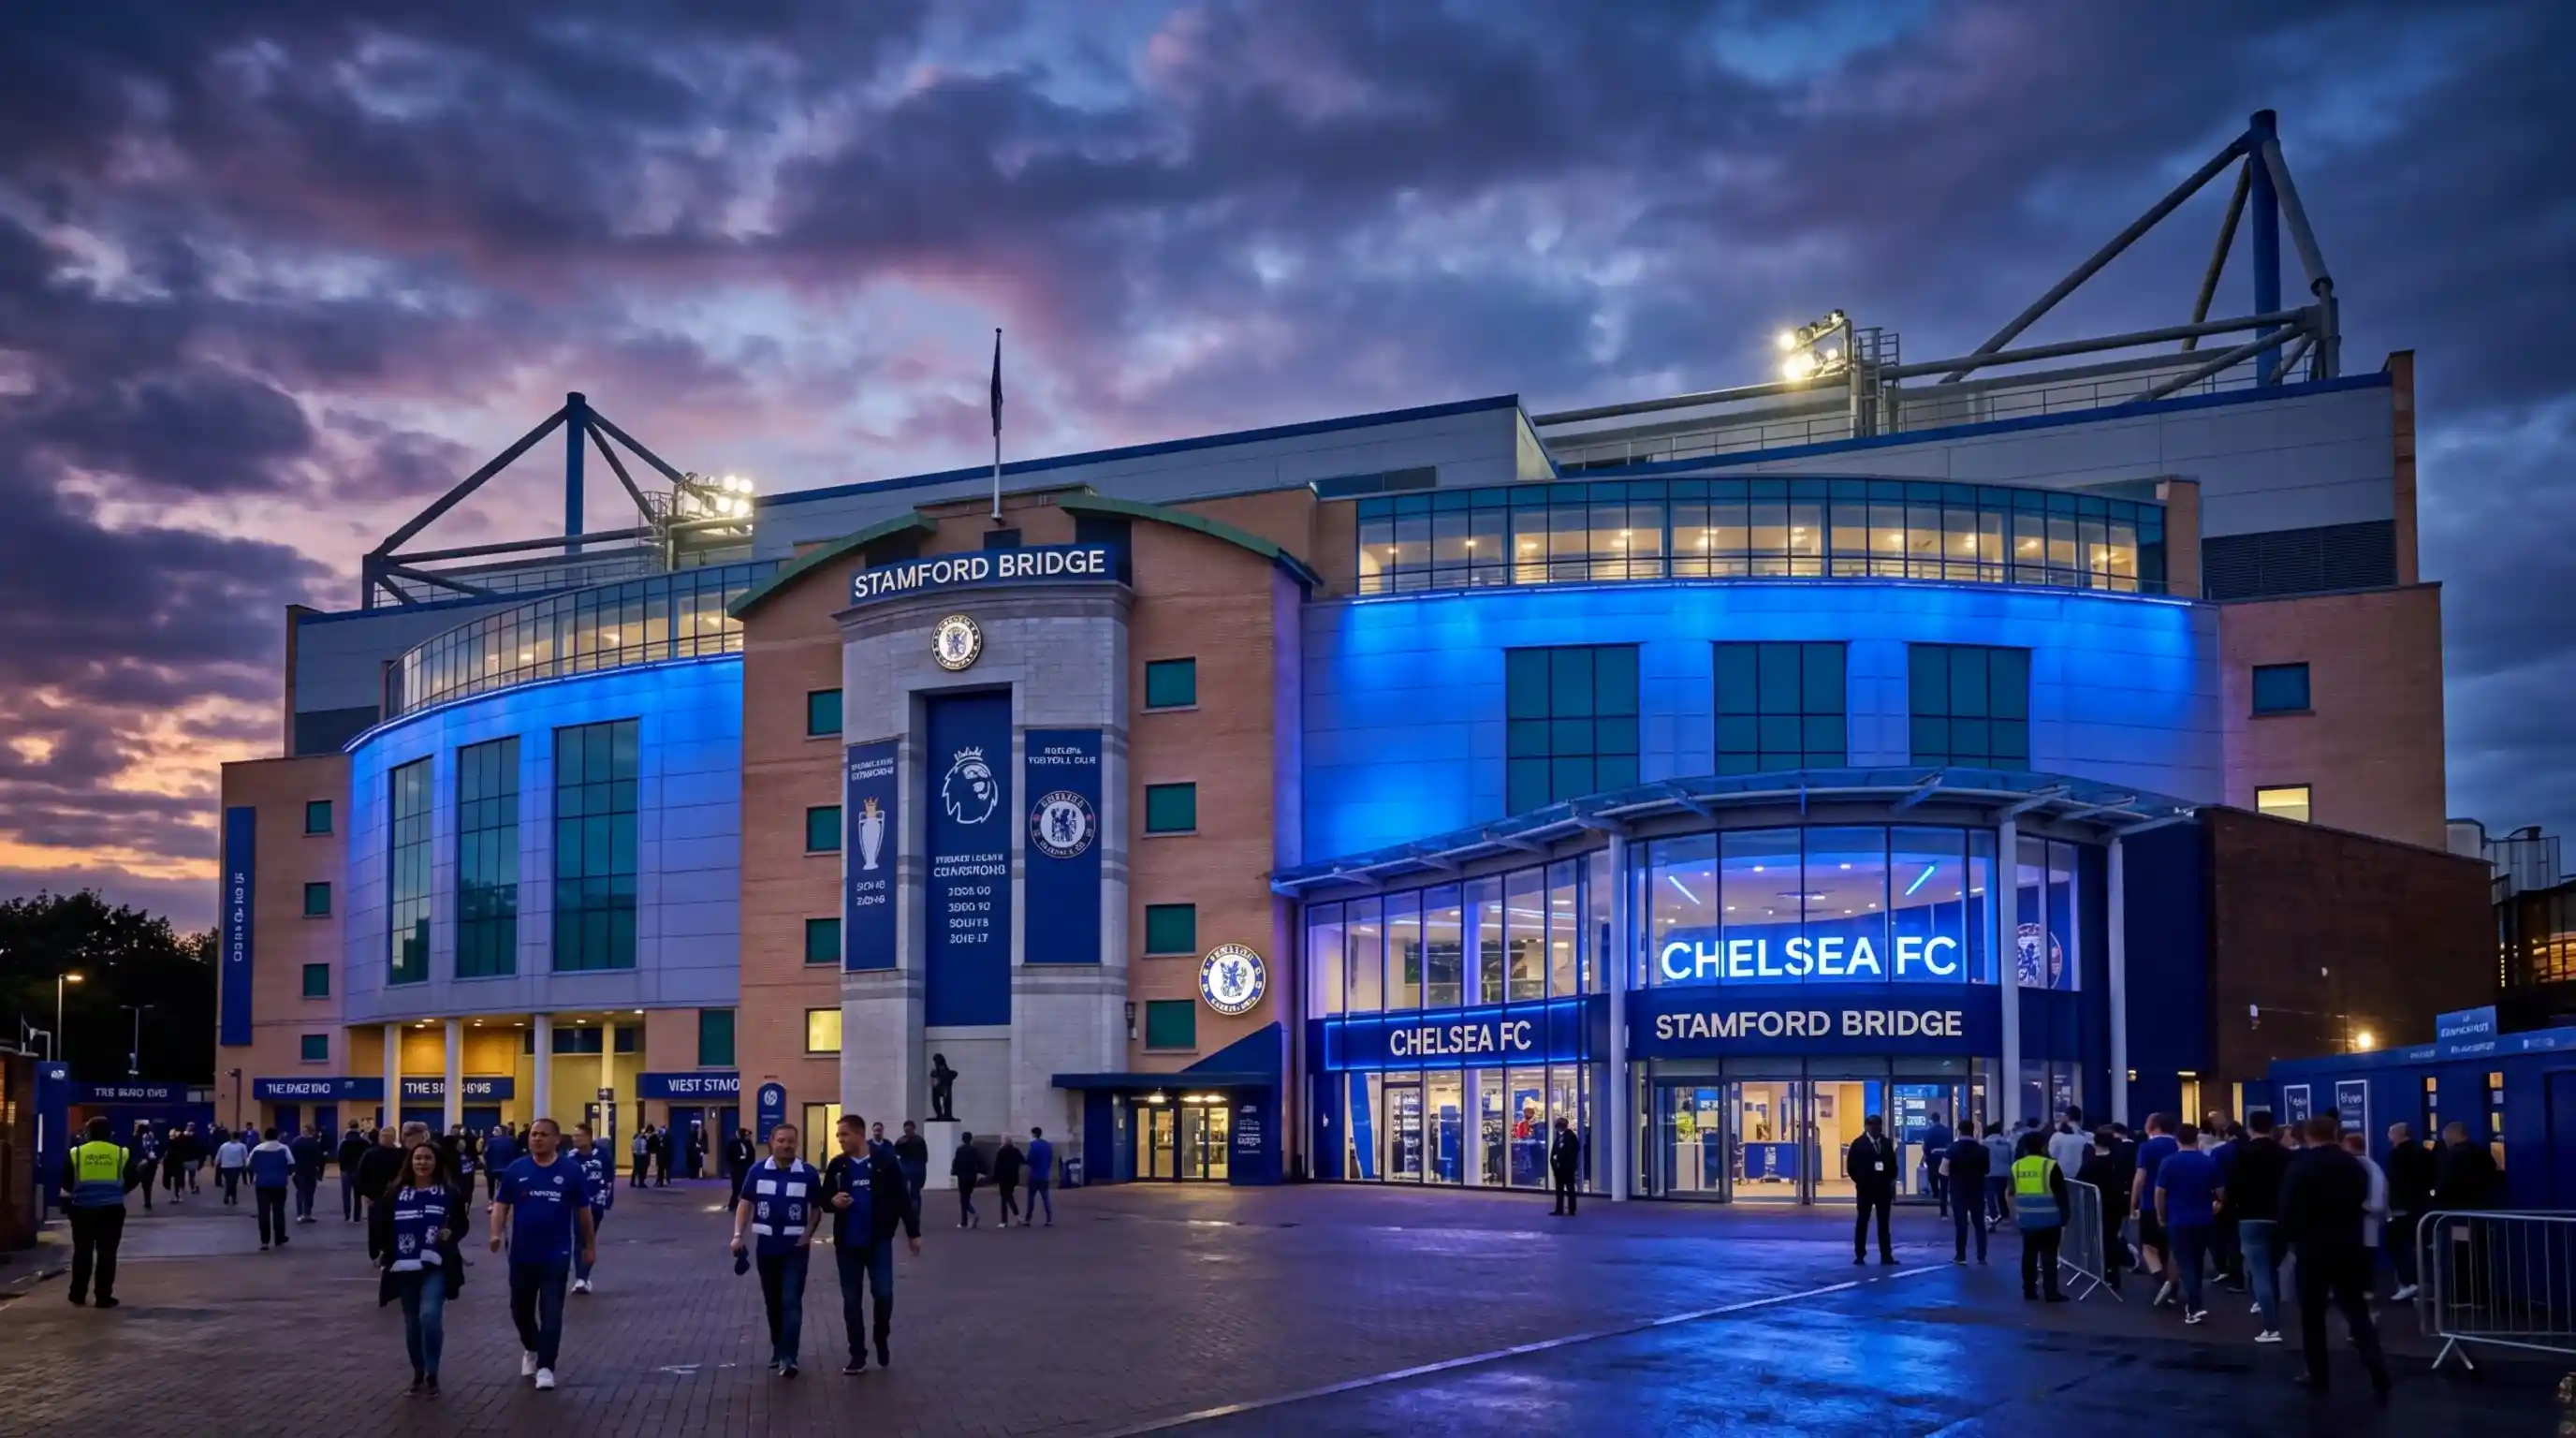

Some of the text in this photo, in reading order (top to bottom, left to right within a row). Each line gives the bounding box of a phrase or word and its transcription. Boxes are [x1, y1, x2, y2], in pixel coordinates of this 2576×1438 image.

[855, 550, 1105, 597] STAMFORD BRIDGE
[1661, 936, 1957, 979] CHELSEA FC
[1390, 1020, 1532, 1056] CHELSEA FC
[1655, 1010, 1963, 1039] STAMFORD BRIDGE
[404, 1082, 431, 1093] THE
